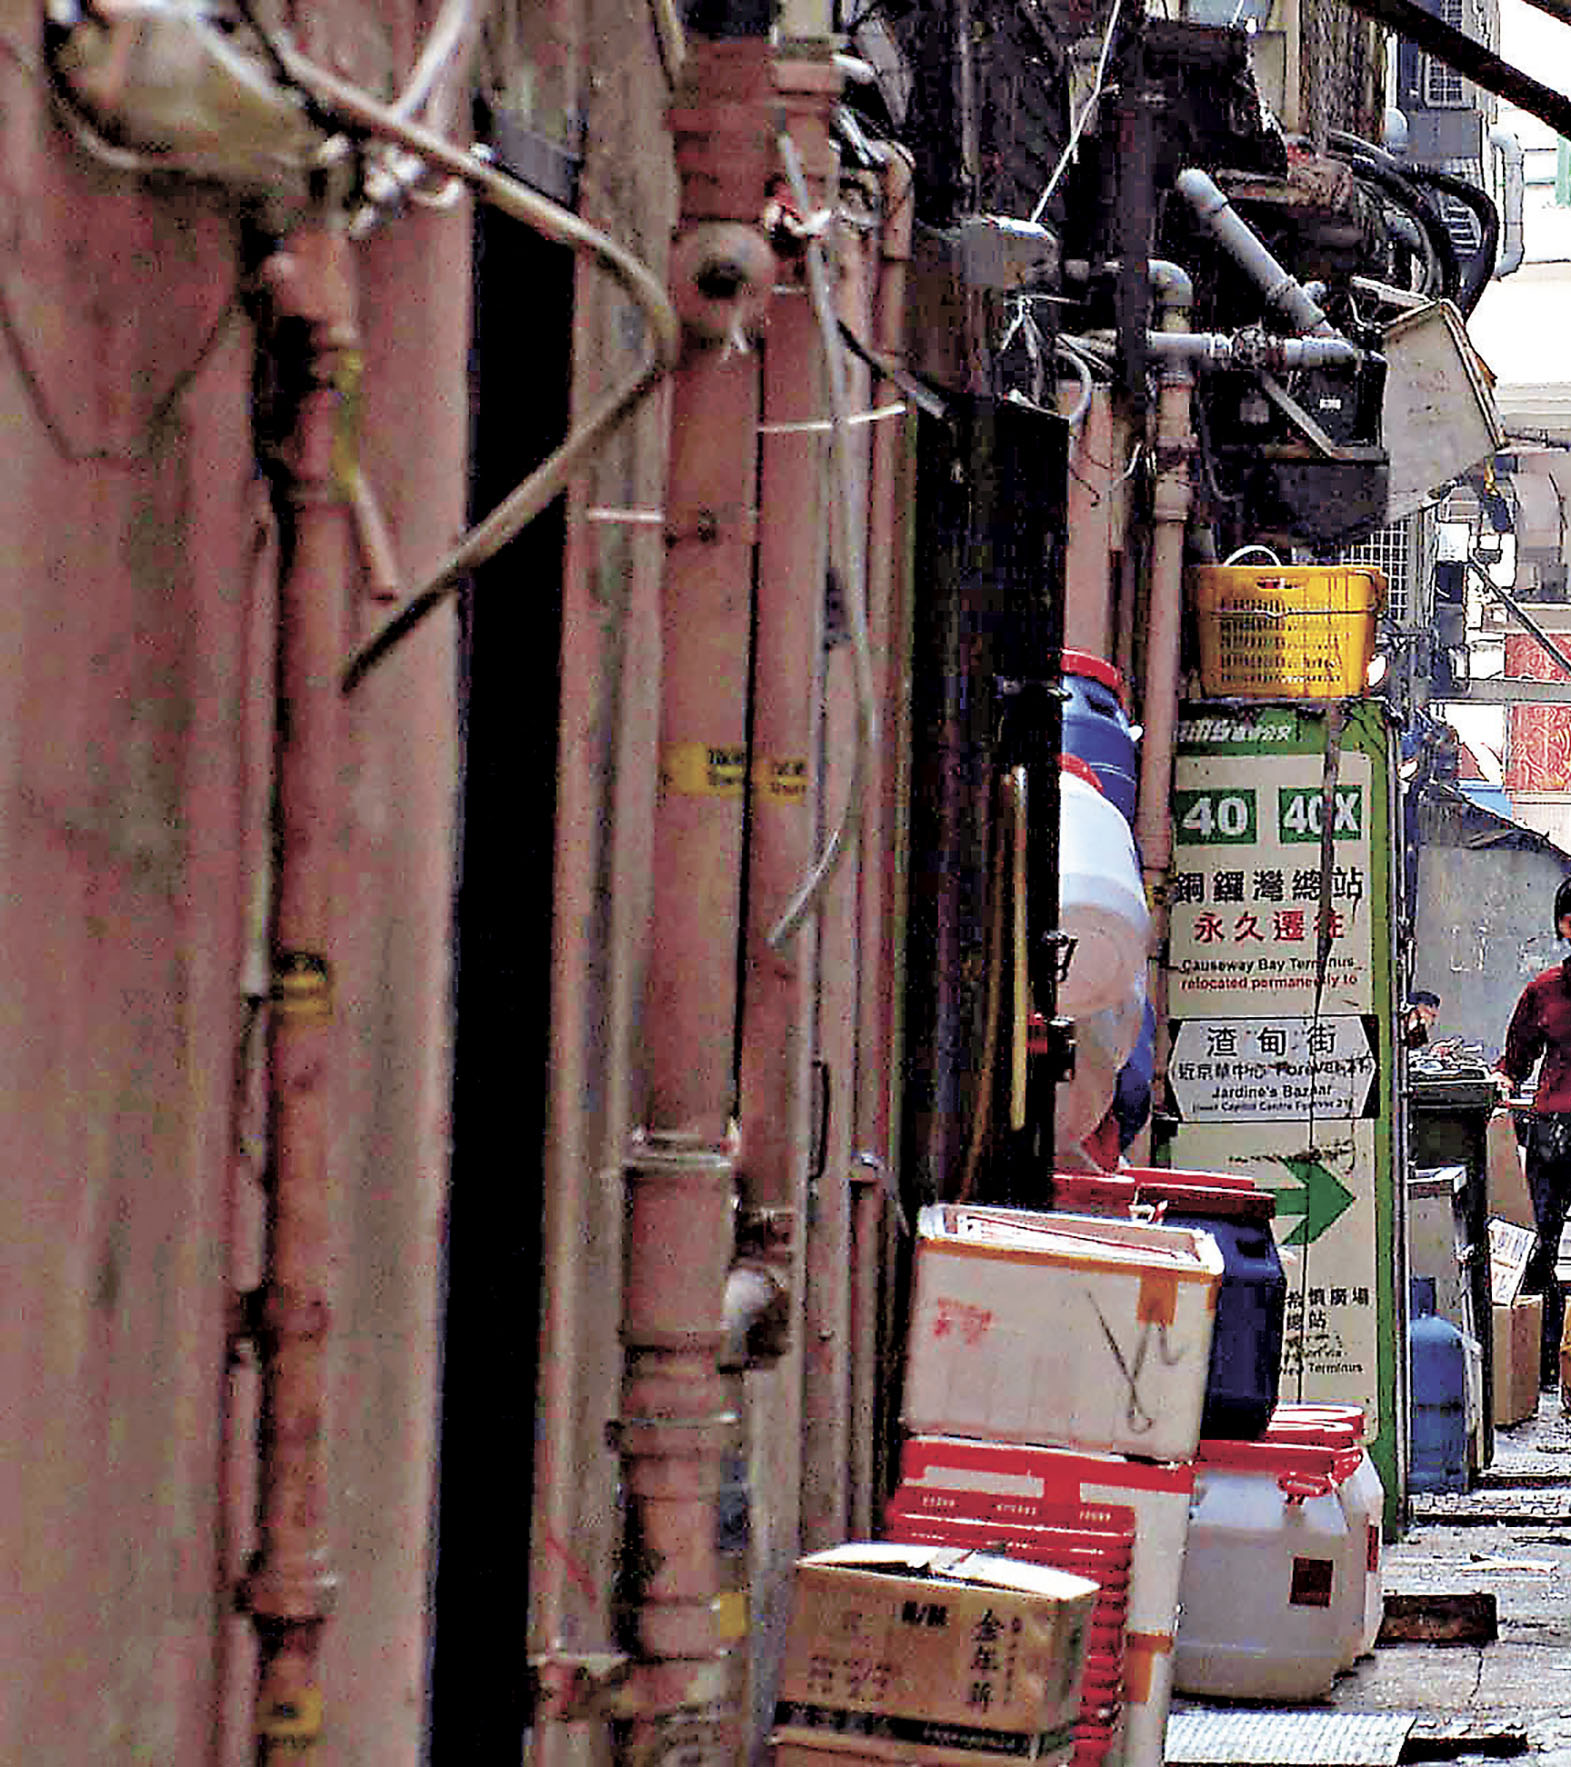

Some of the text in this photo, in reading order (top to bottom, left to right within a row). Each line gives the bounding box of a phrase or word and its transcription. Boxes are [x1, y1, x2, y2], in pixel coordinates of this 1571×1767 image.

[1183, 797, 1249, 835] 40
[1284, 792, 1359, 834] 40X
[1258, 957, 1285, 973] Bay
[1289, 957, 1354, 970] Termnus
[1343, 974, 1358, 985] to
[1207, 1024, 1336, 1057] 渣甸街
[1212, 1085, 1278, 1099] Jardine's
